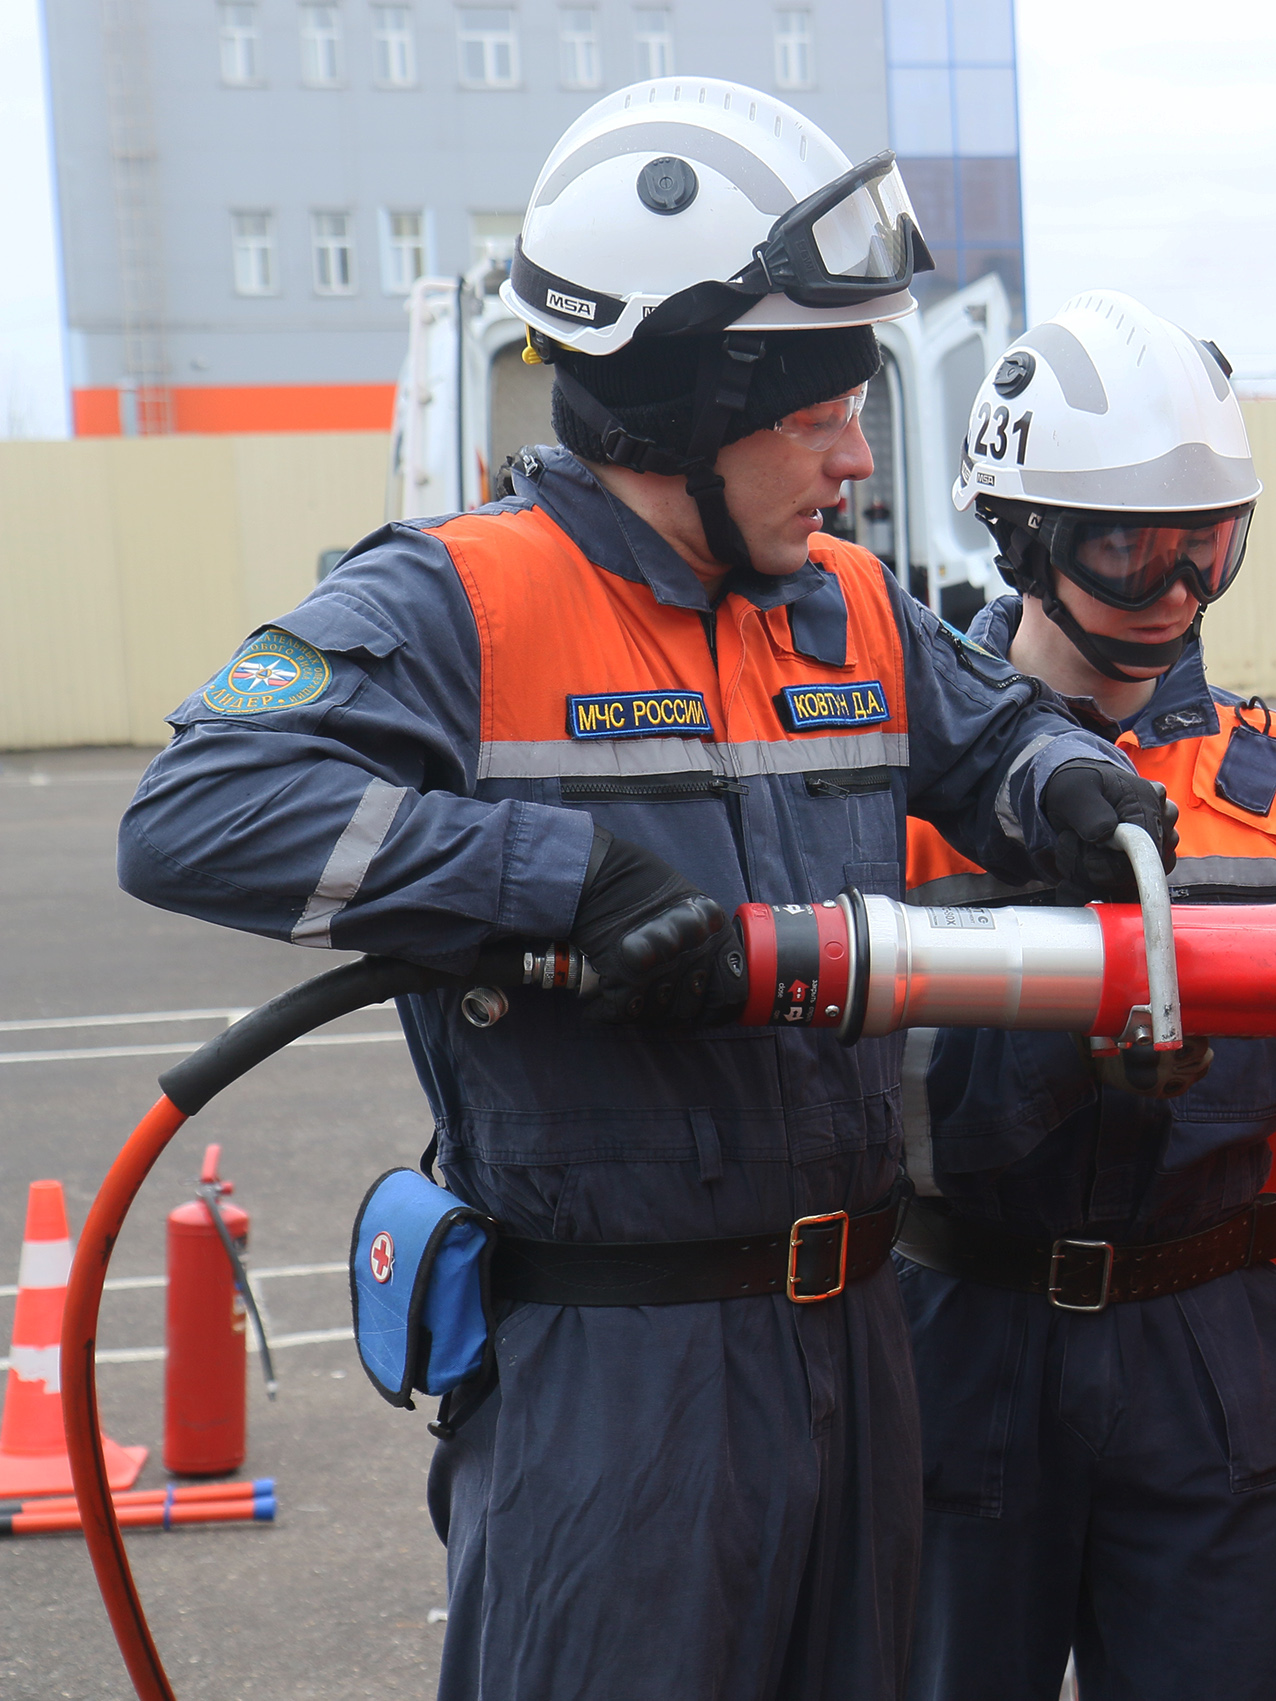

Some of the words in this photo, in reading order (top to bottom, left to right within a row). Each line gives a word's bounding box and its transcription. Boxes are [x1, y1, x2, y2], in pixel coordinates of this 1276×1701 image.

[549, 294, 591, 315] MSA
[974, 401, 1034, 466] 231
[977, 473, 994, 485] MSA
[257, 633, 320, 665] АТЕЛЬНЫХ
[211, 688, 274, 709] ЛИДЕР
[795, 693, 850, 719] КОВТУН
[853, 690, 884, 719] Д.А.
[578, 702, 625, 732] МЧС
[633, 698, 707, 727] РОССИИ
